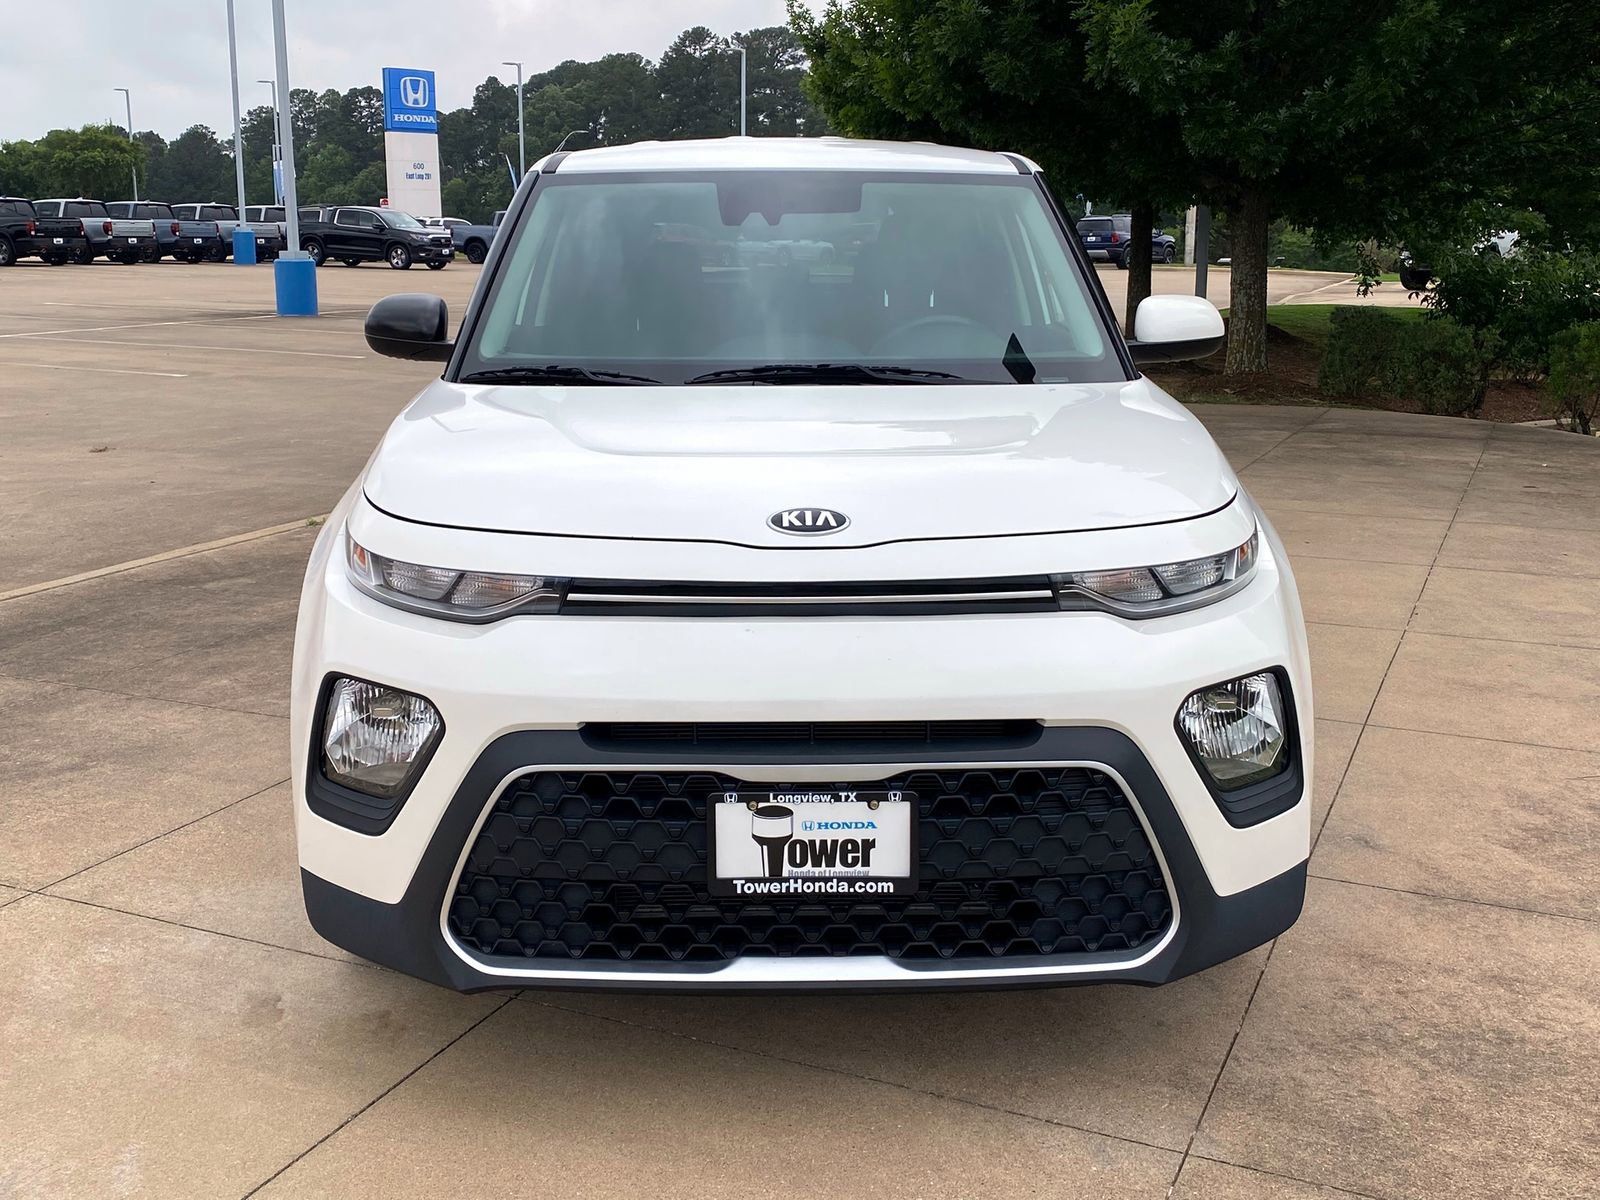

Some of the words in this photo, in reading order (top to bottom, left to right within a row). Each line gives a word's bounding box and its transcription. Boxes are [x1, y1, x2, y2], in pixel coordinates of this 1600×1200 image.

[393, 114, 436, 124] HONDA
[412, 162, 425, 170] 600
[782, 510, 837, 527] KIA
[769, 792, 834, 804] Longview,
[839, 792, 857, 802] TX
[817, 821, 877, 829] HONDA
[751, 805, 876, 877] Tower
[788, 869, 816, 877] Honda
[818, 869, 826, 877] of
[733, 879, 894, 894] TowerHonda.com
